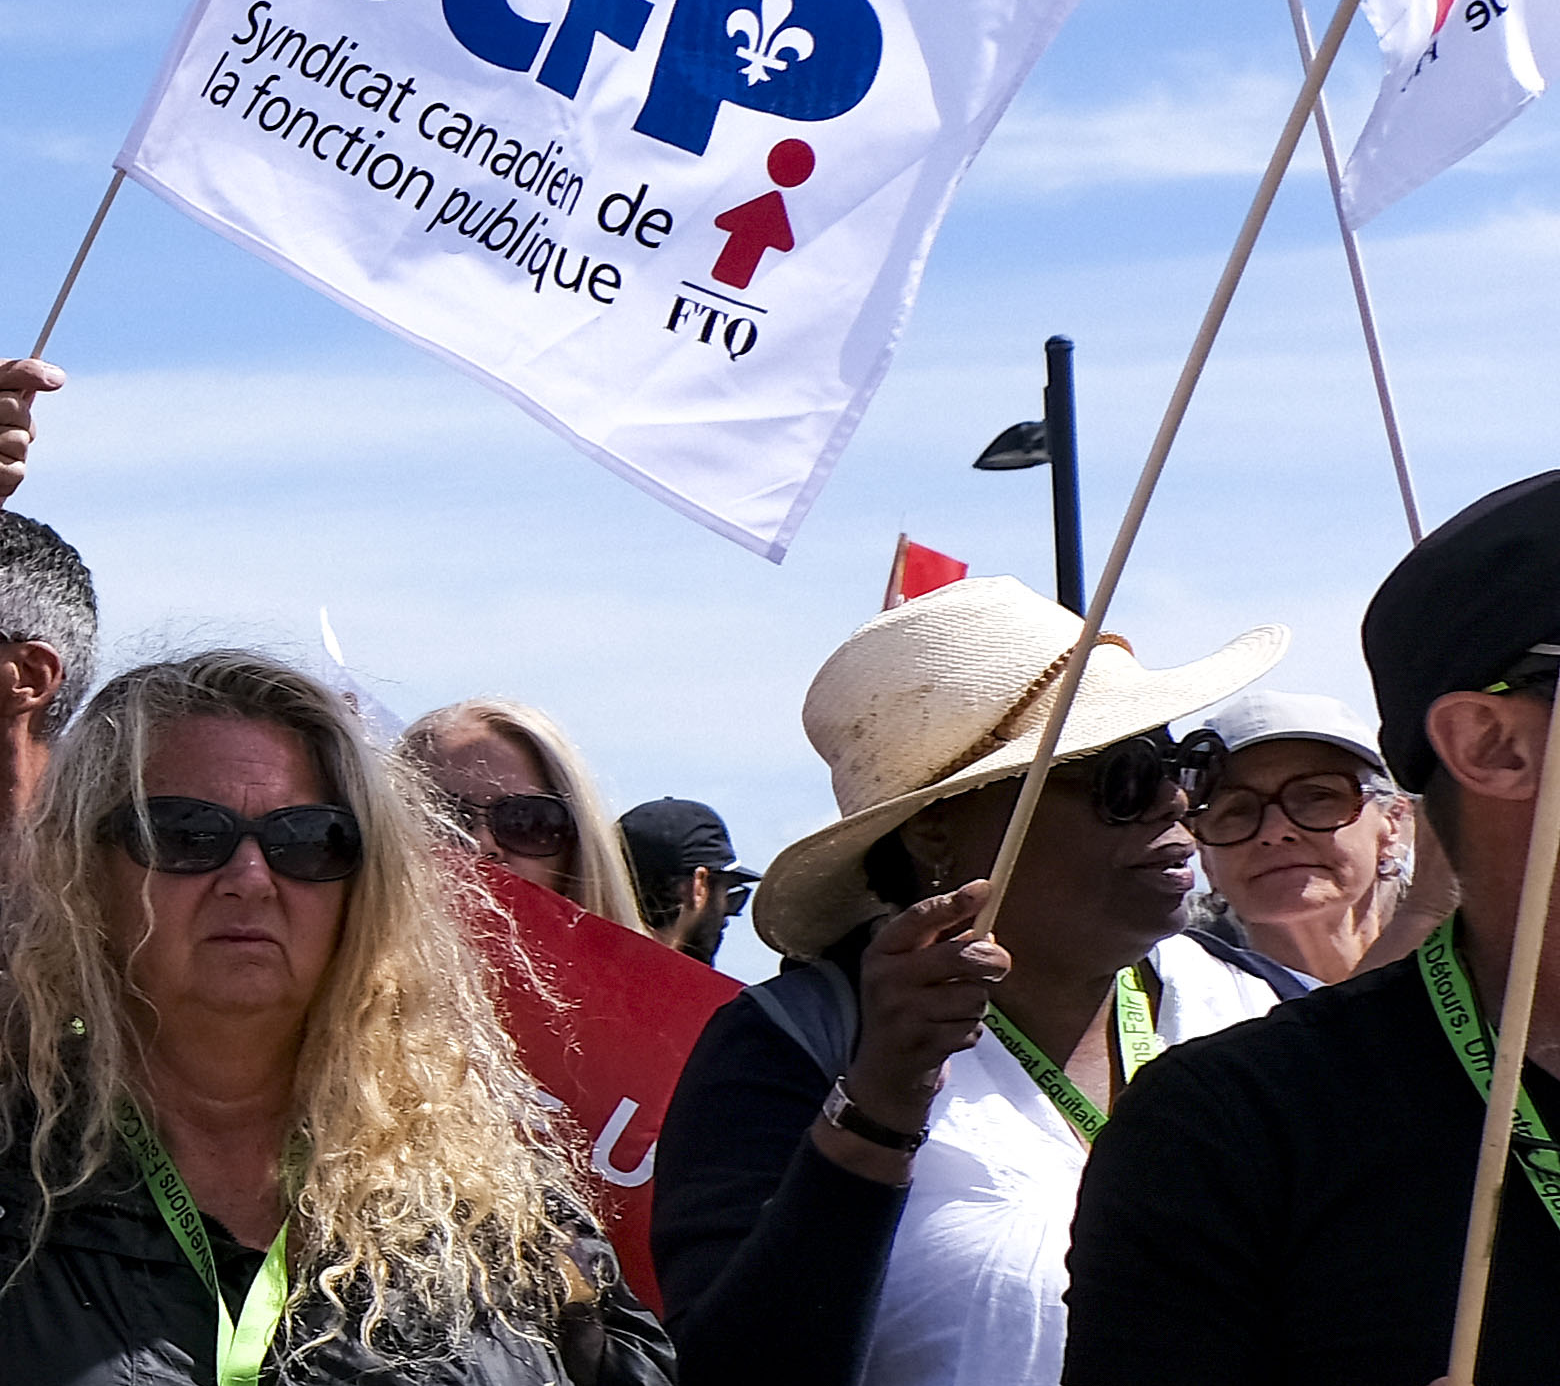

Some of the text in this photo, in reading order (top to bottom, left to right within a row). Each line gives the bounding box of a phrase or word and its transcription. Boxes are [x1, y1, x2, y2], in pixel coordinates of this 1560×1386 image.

[201, 50, 623, 307] la fonction publique
[231, 0, 674, 251] Syndicat canadien de
[662, 292, 762, 363] FTQ
